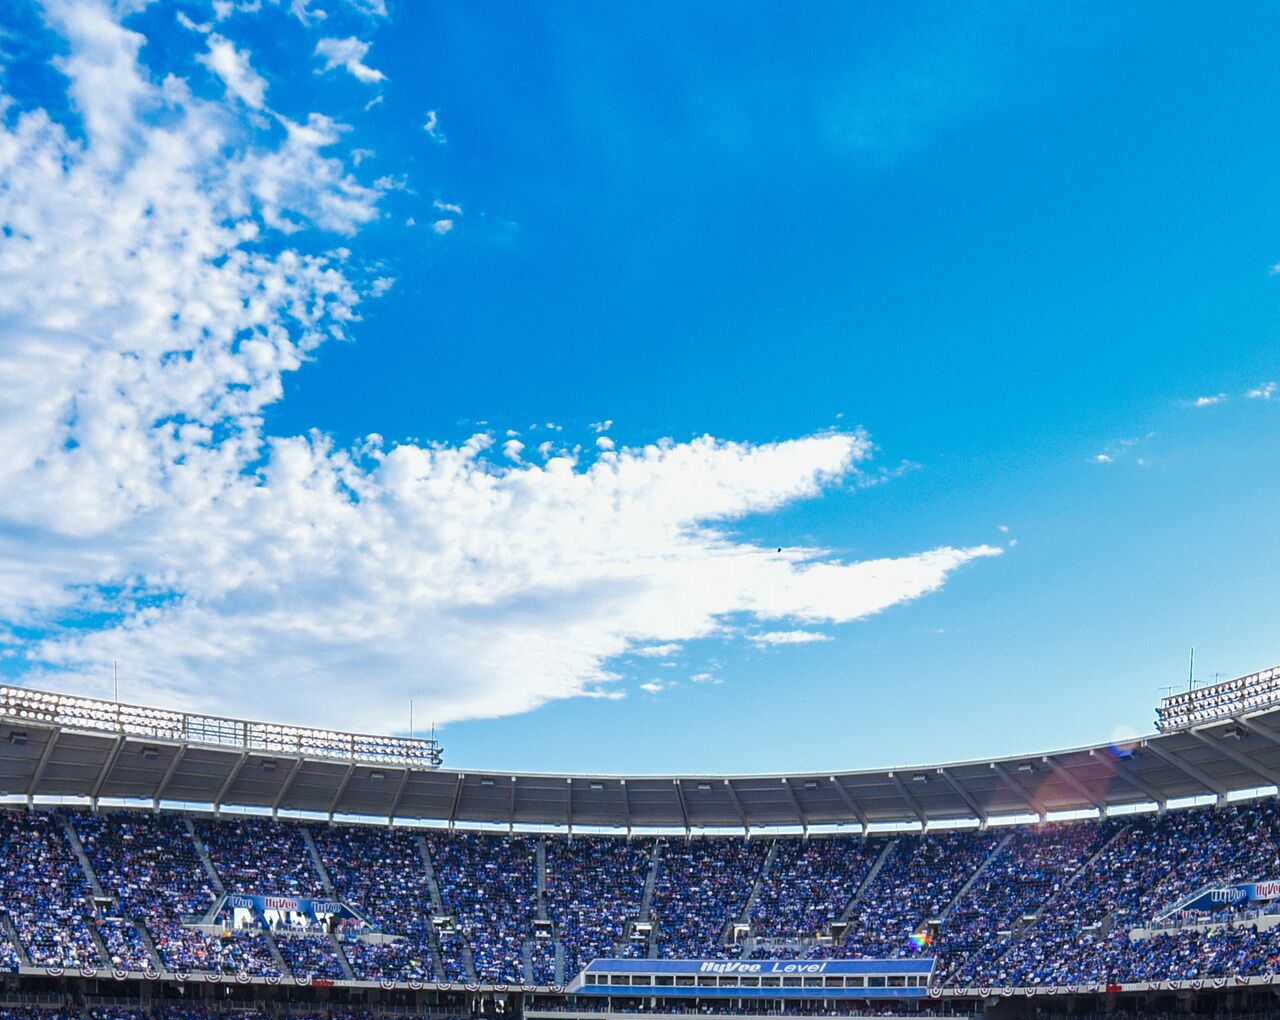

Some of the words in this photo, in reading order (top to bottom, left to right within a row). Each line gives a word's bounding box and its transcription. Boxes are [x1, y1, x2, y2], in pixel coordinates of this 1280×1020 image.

[265, 898, 298, 910] HyVee
[700, 961, 761, 974] HyVee
[771, 961, 827, 974] Level
